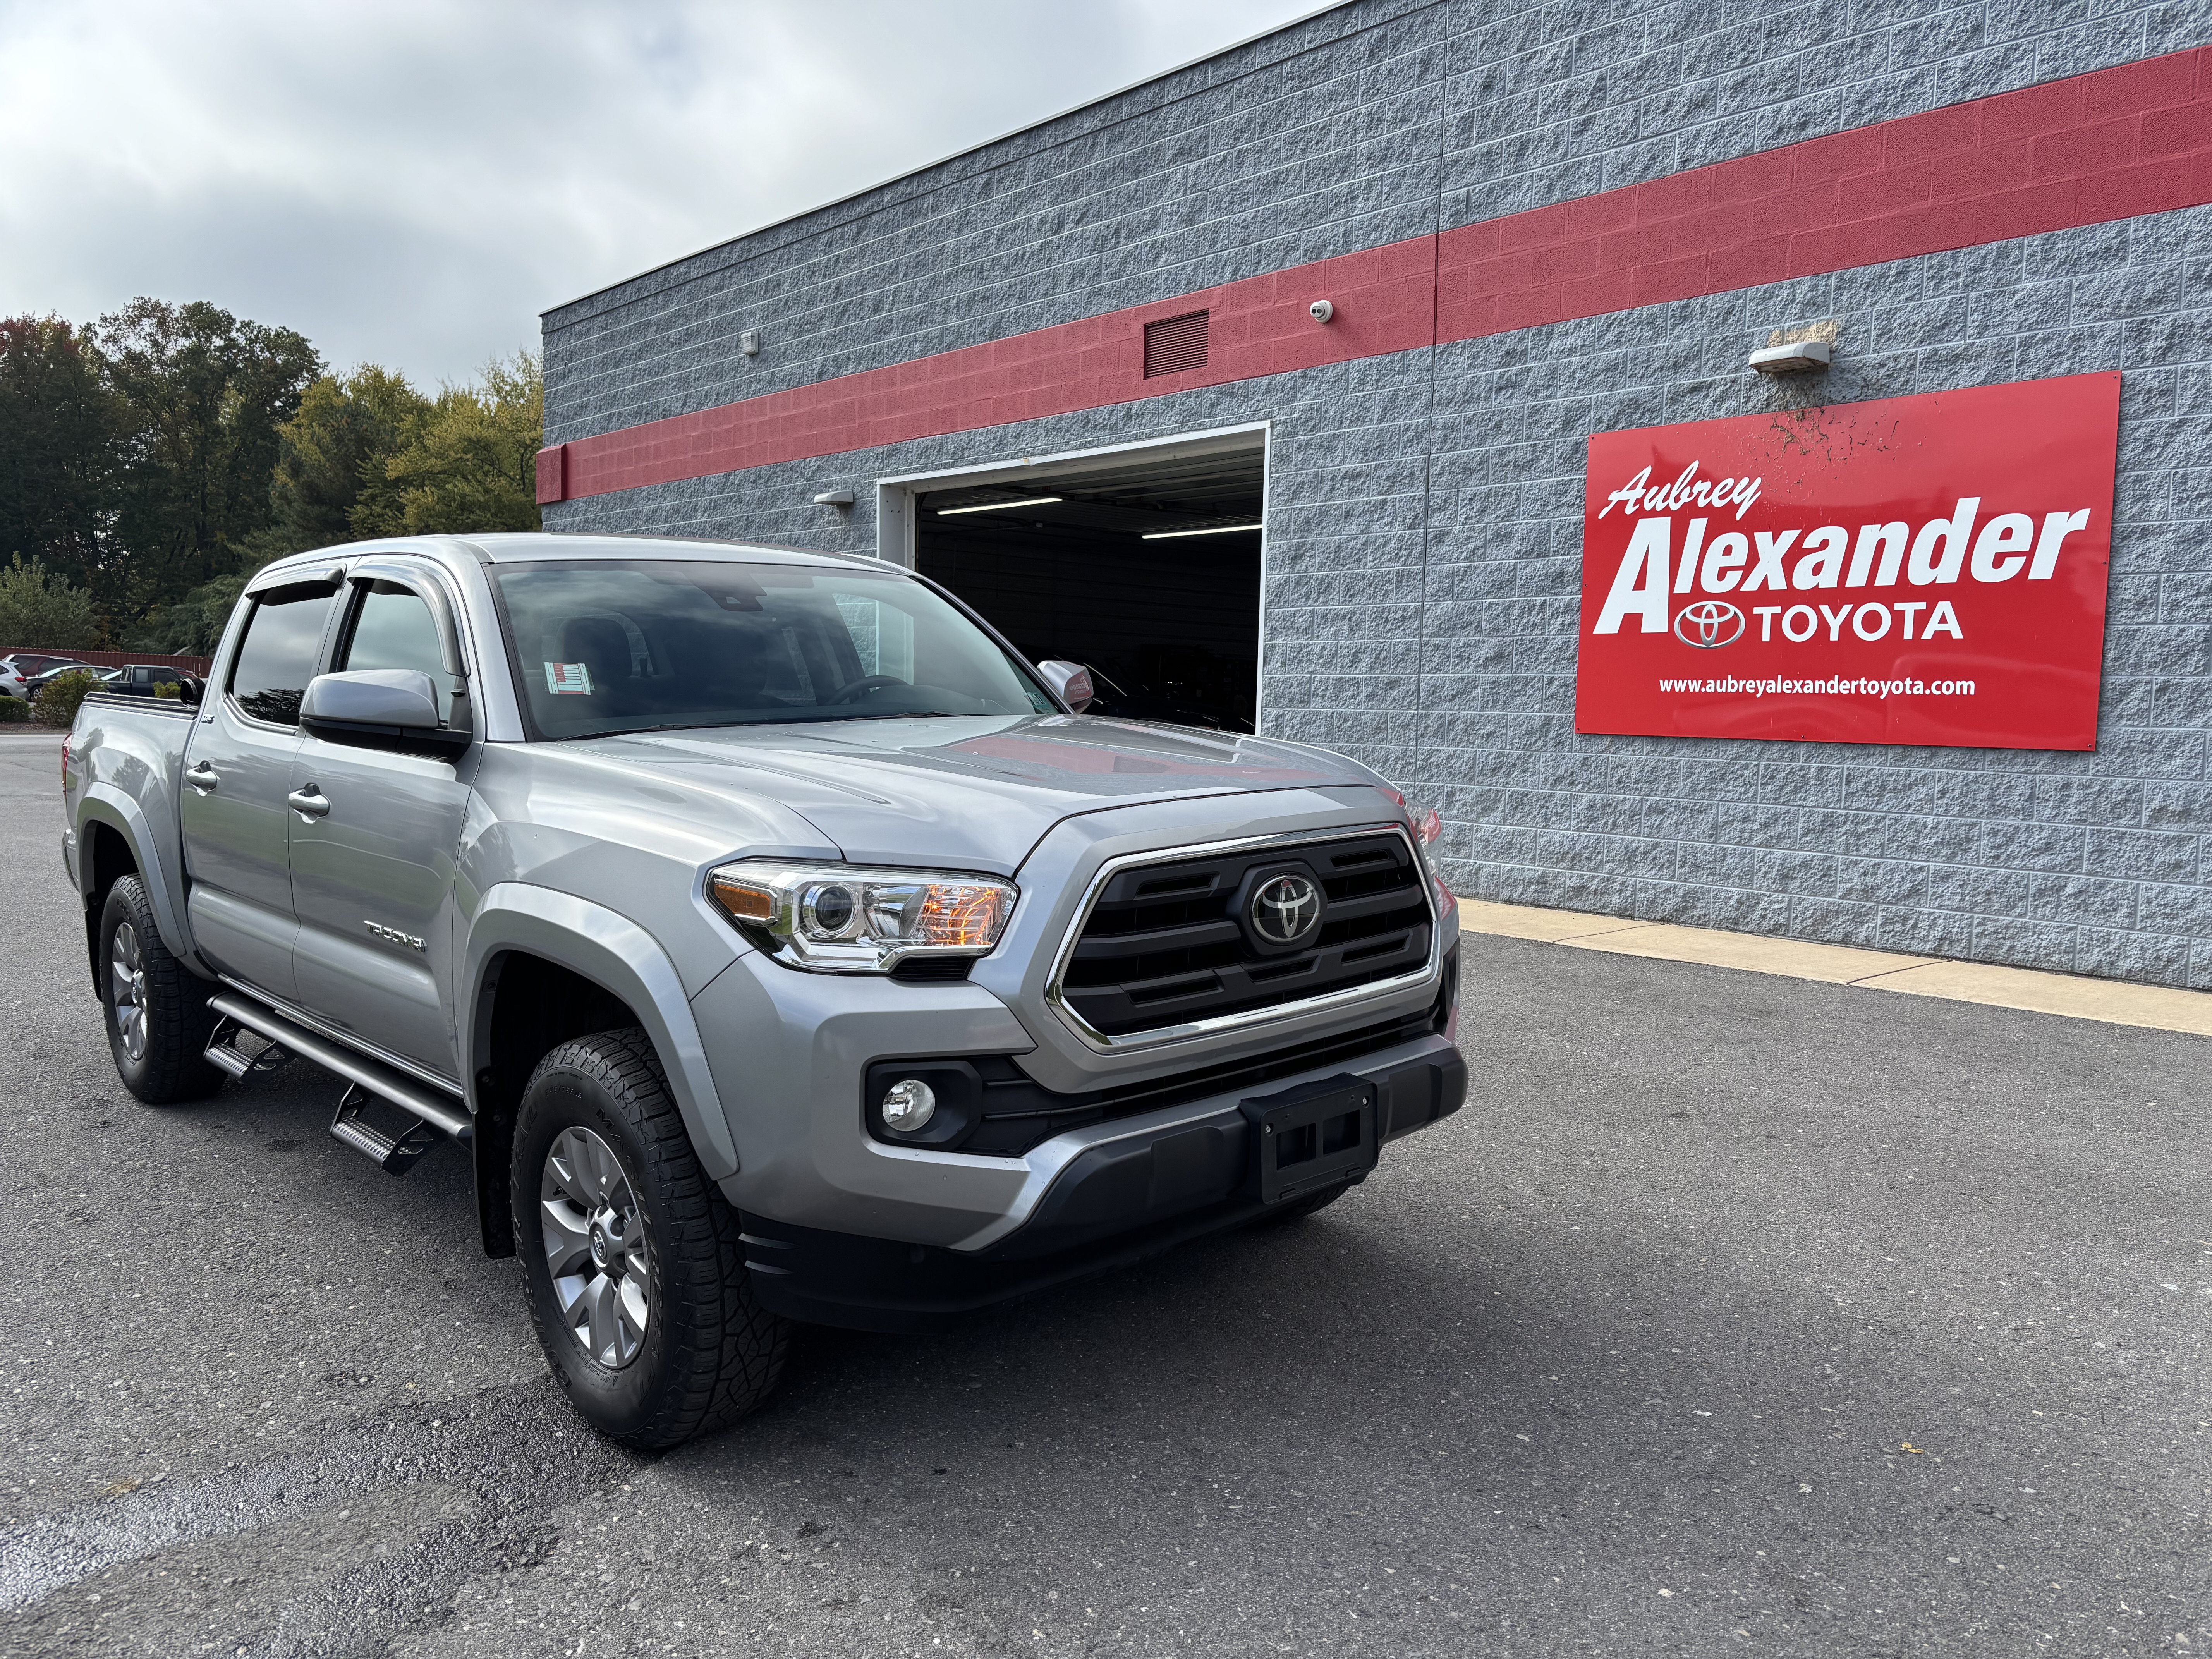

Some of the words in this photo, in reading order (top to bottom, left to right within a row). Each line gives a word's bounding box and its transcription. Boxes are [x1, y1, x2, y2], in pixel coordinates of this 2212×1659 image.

[1598, 460, 1762, 520] Aubrey
[1593, 497, 2091, 634] Alexander
[1753, 601, 1964, 642] TOYOTA
[1660, 675, 1975, 700] www.aubreyalexandertoyota.com
